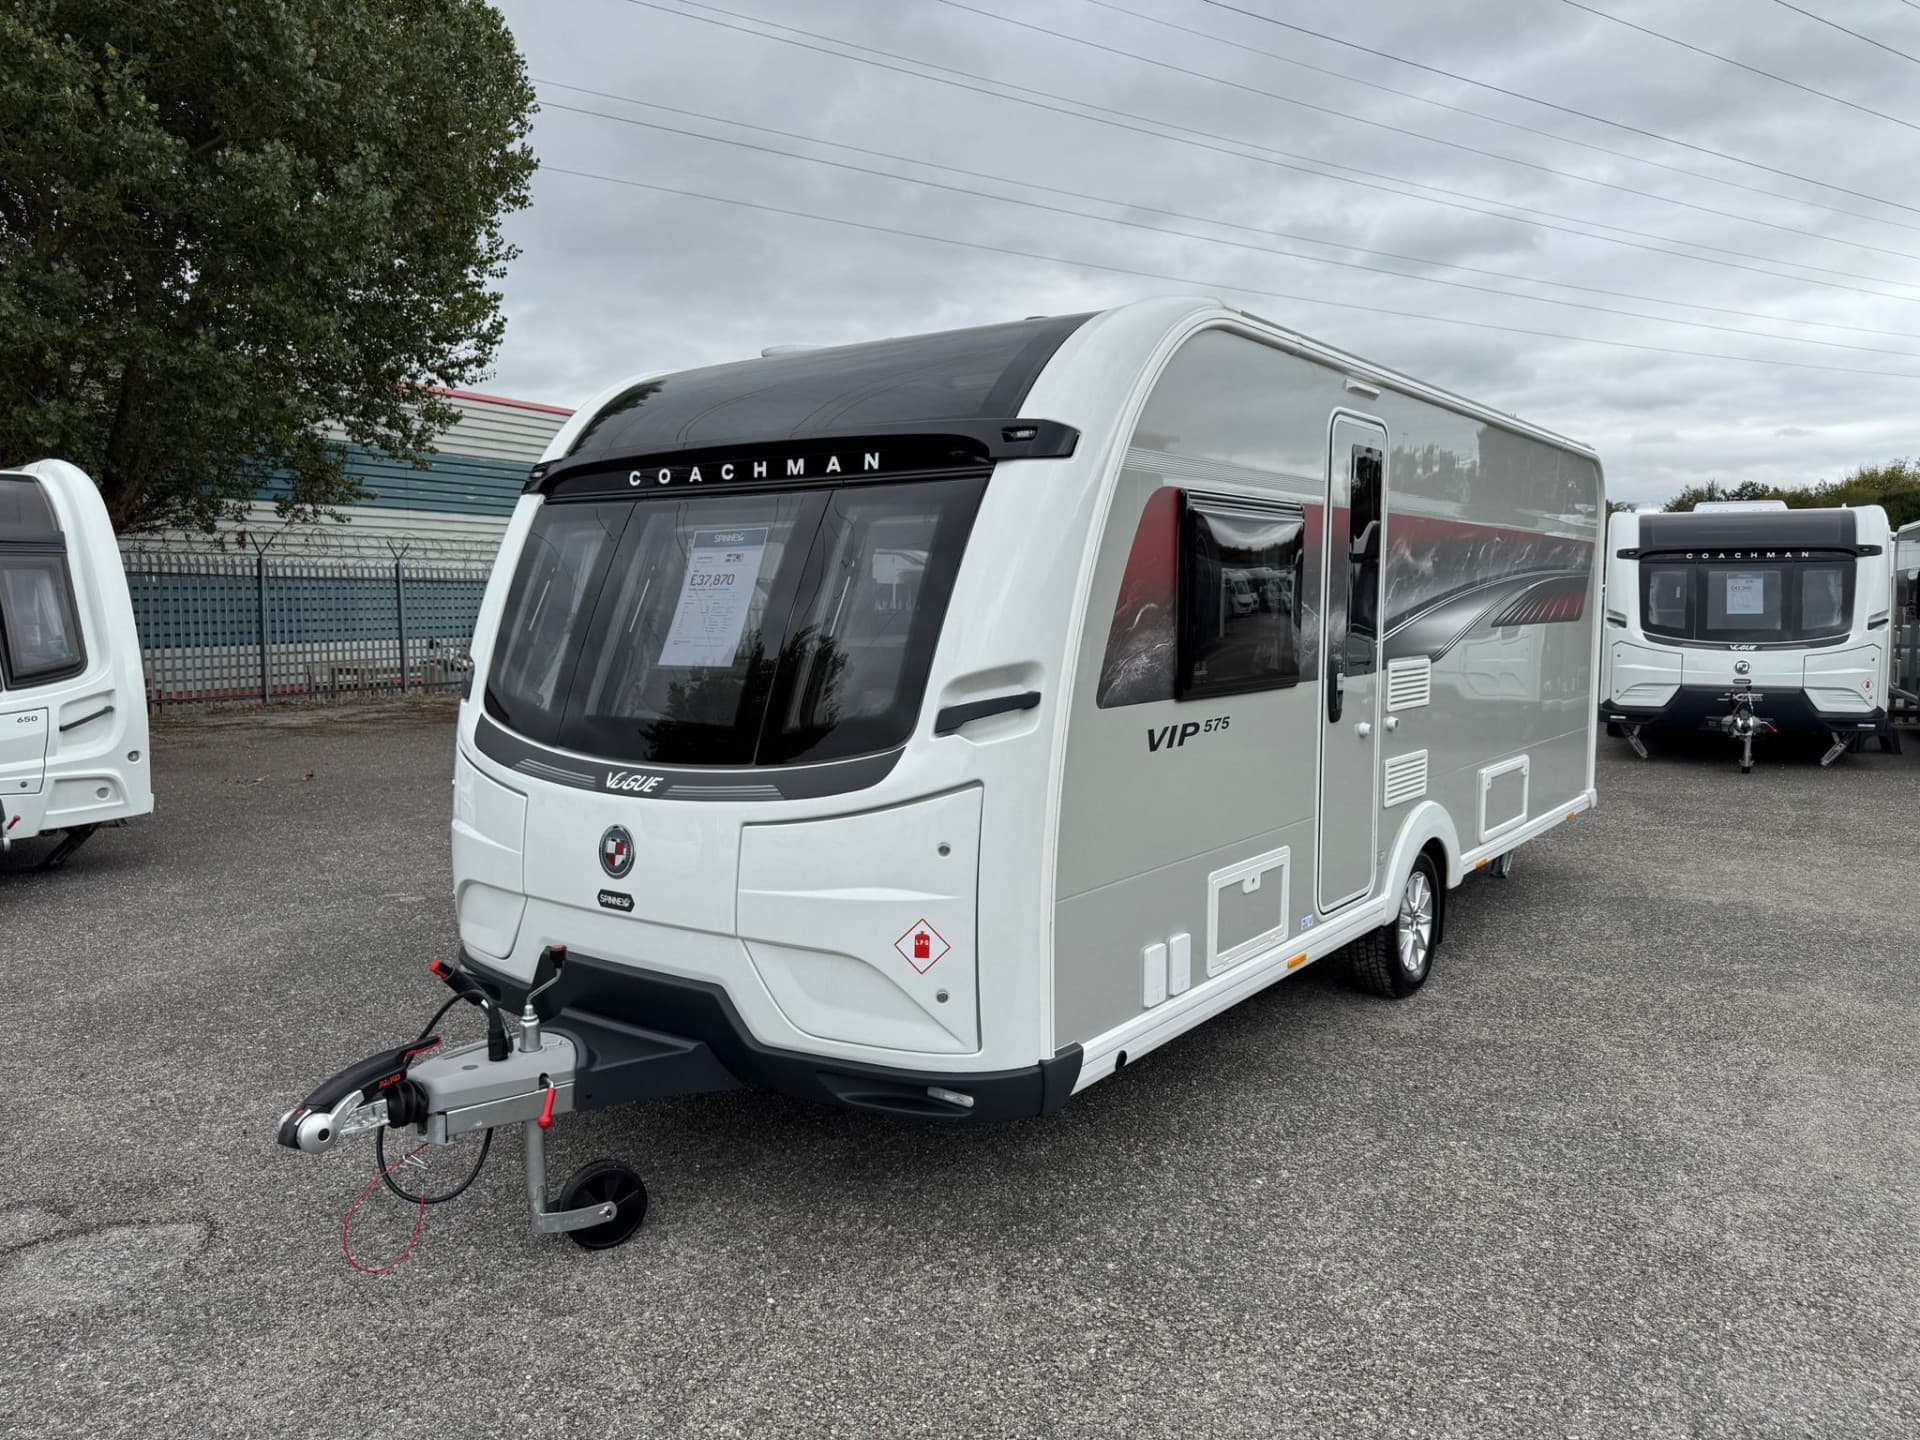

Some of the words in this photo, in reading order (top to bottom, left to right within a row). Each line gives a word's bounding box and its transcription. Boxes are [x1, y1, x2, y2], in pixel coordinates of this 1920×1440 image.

[629, 452, 880, 487] COACHMAN
[1686, 551, 1809, 559] COACHMAN
[689, 573, 735, 588] £37,870
[16, 715, 39, 724] 650
[1147, 721, 1201, 753] VIP
[1203, 715, 1231, 733] 575
[605, 770, 665, 793] VOGUE
